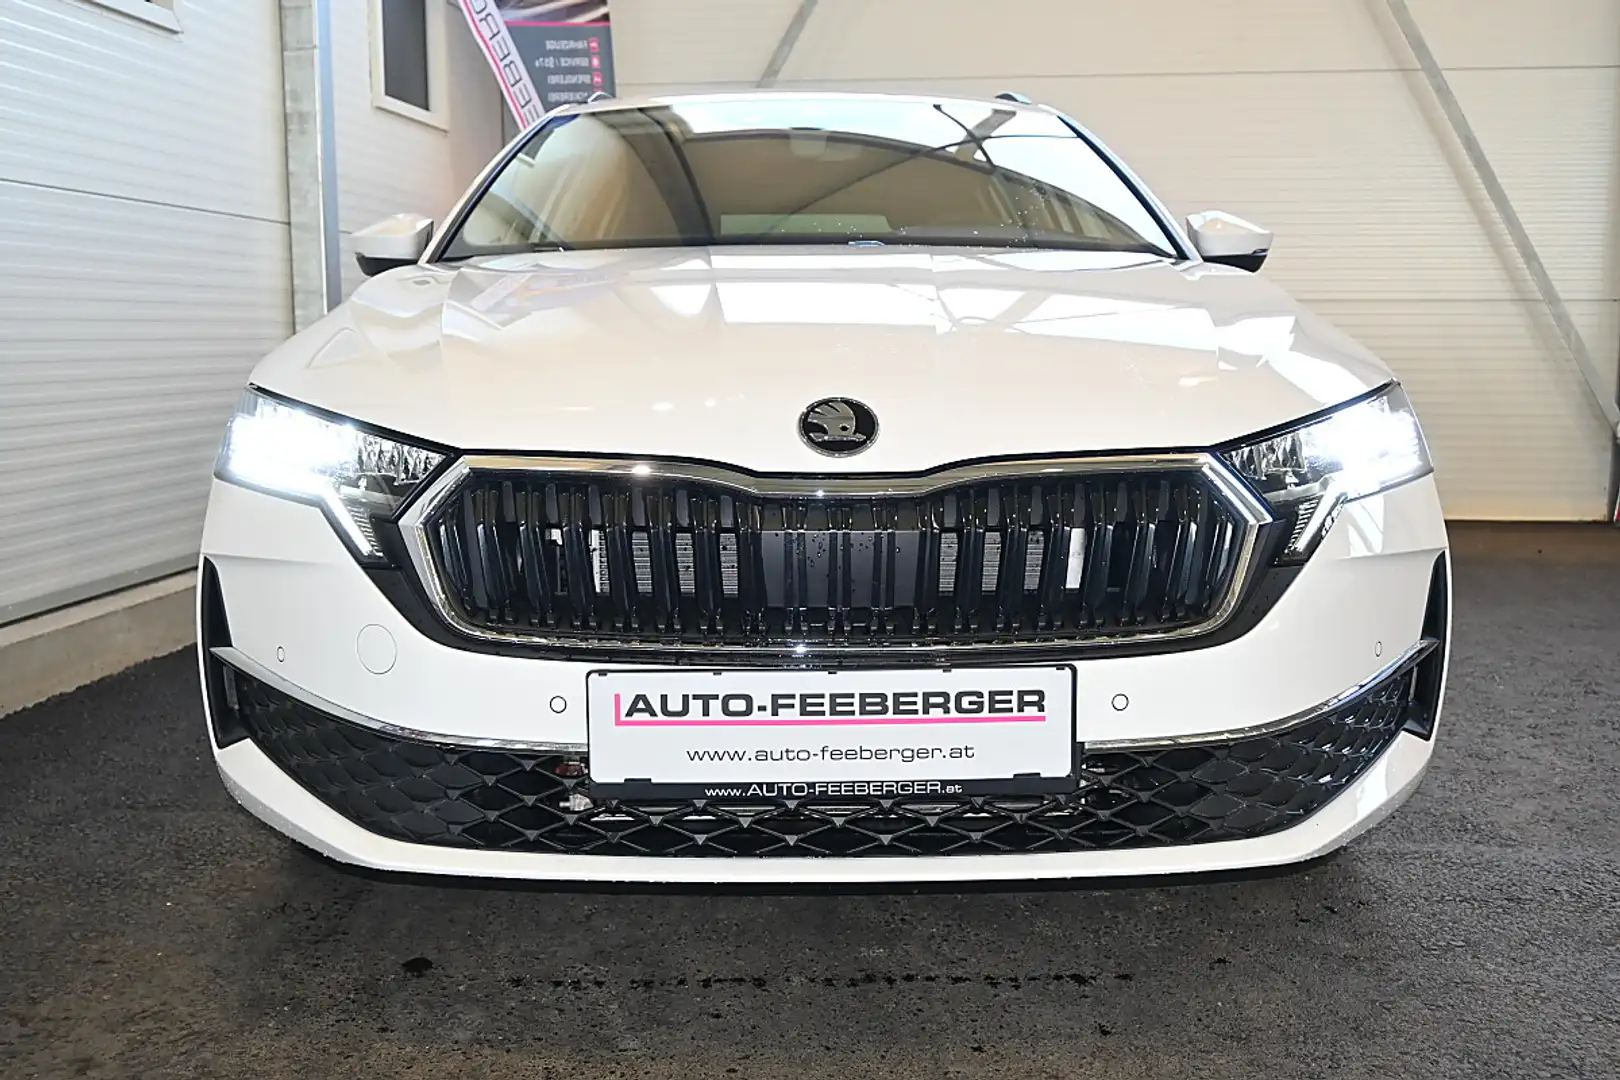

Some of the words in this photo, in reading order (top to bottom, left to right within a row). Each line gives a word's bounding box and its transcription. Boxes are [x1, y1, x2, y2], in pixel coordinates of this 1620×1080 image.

[625, 689, 1046, 718] AUTO-FEEBERGER
[686, 745, 975, 763] www.auto-feeberger.at
[704, 781, 963, 797] www.AUTO-FEEBERGER.at
